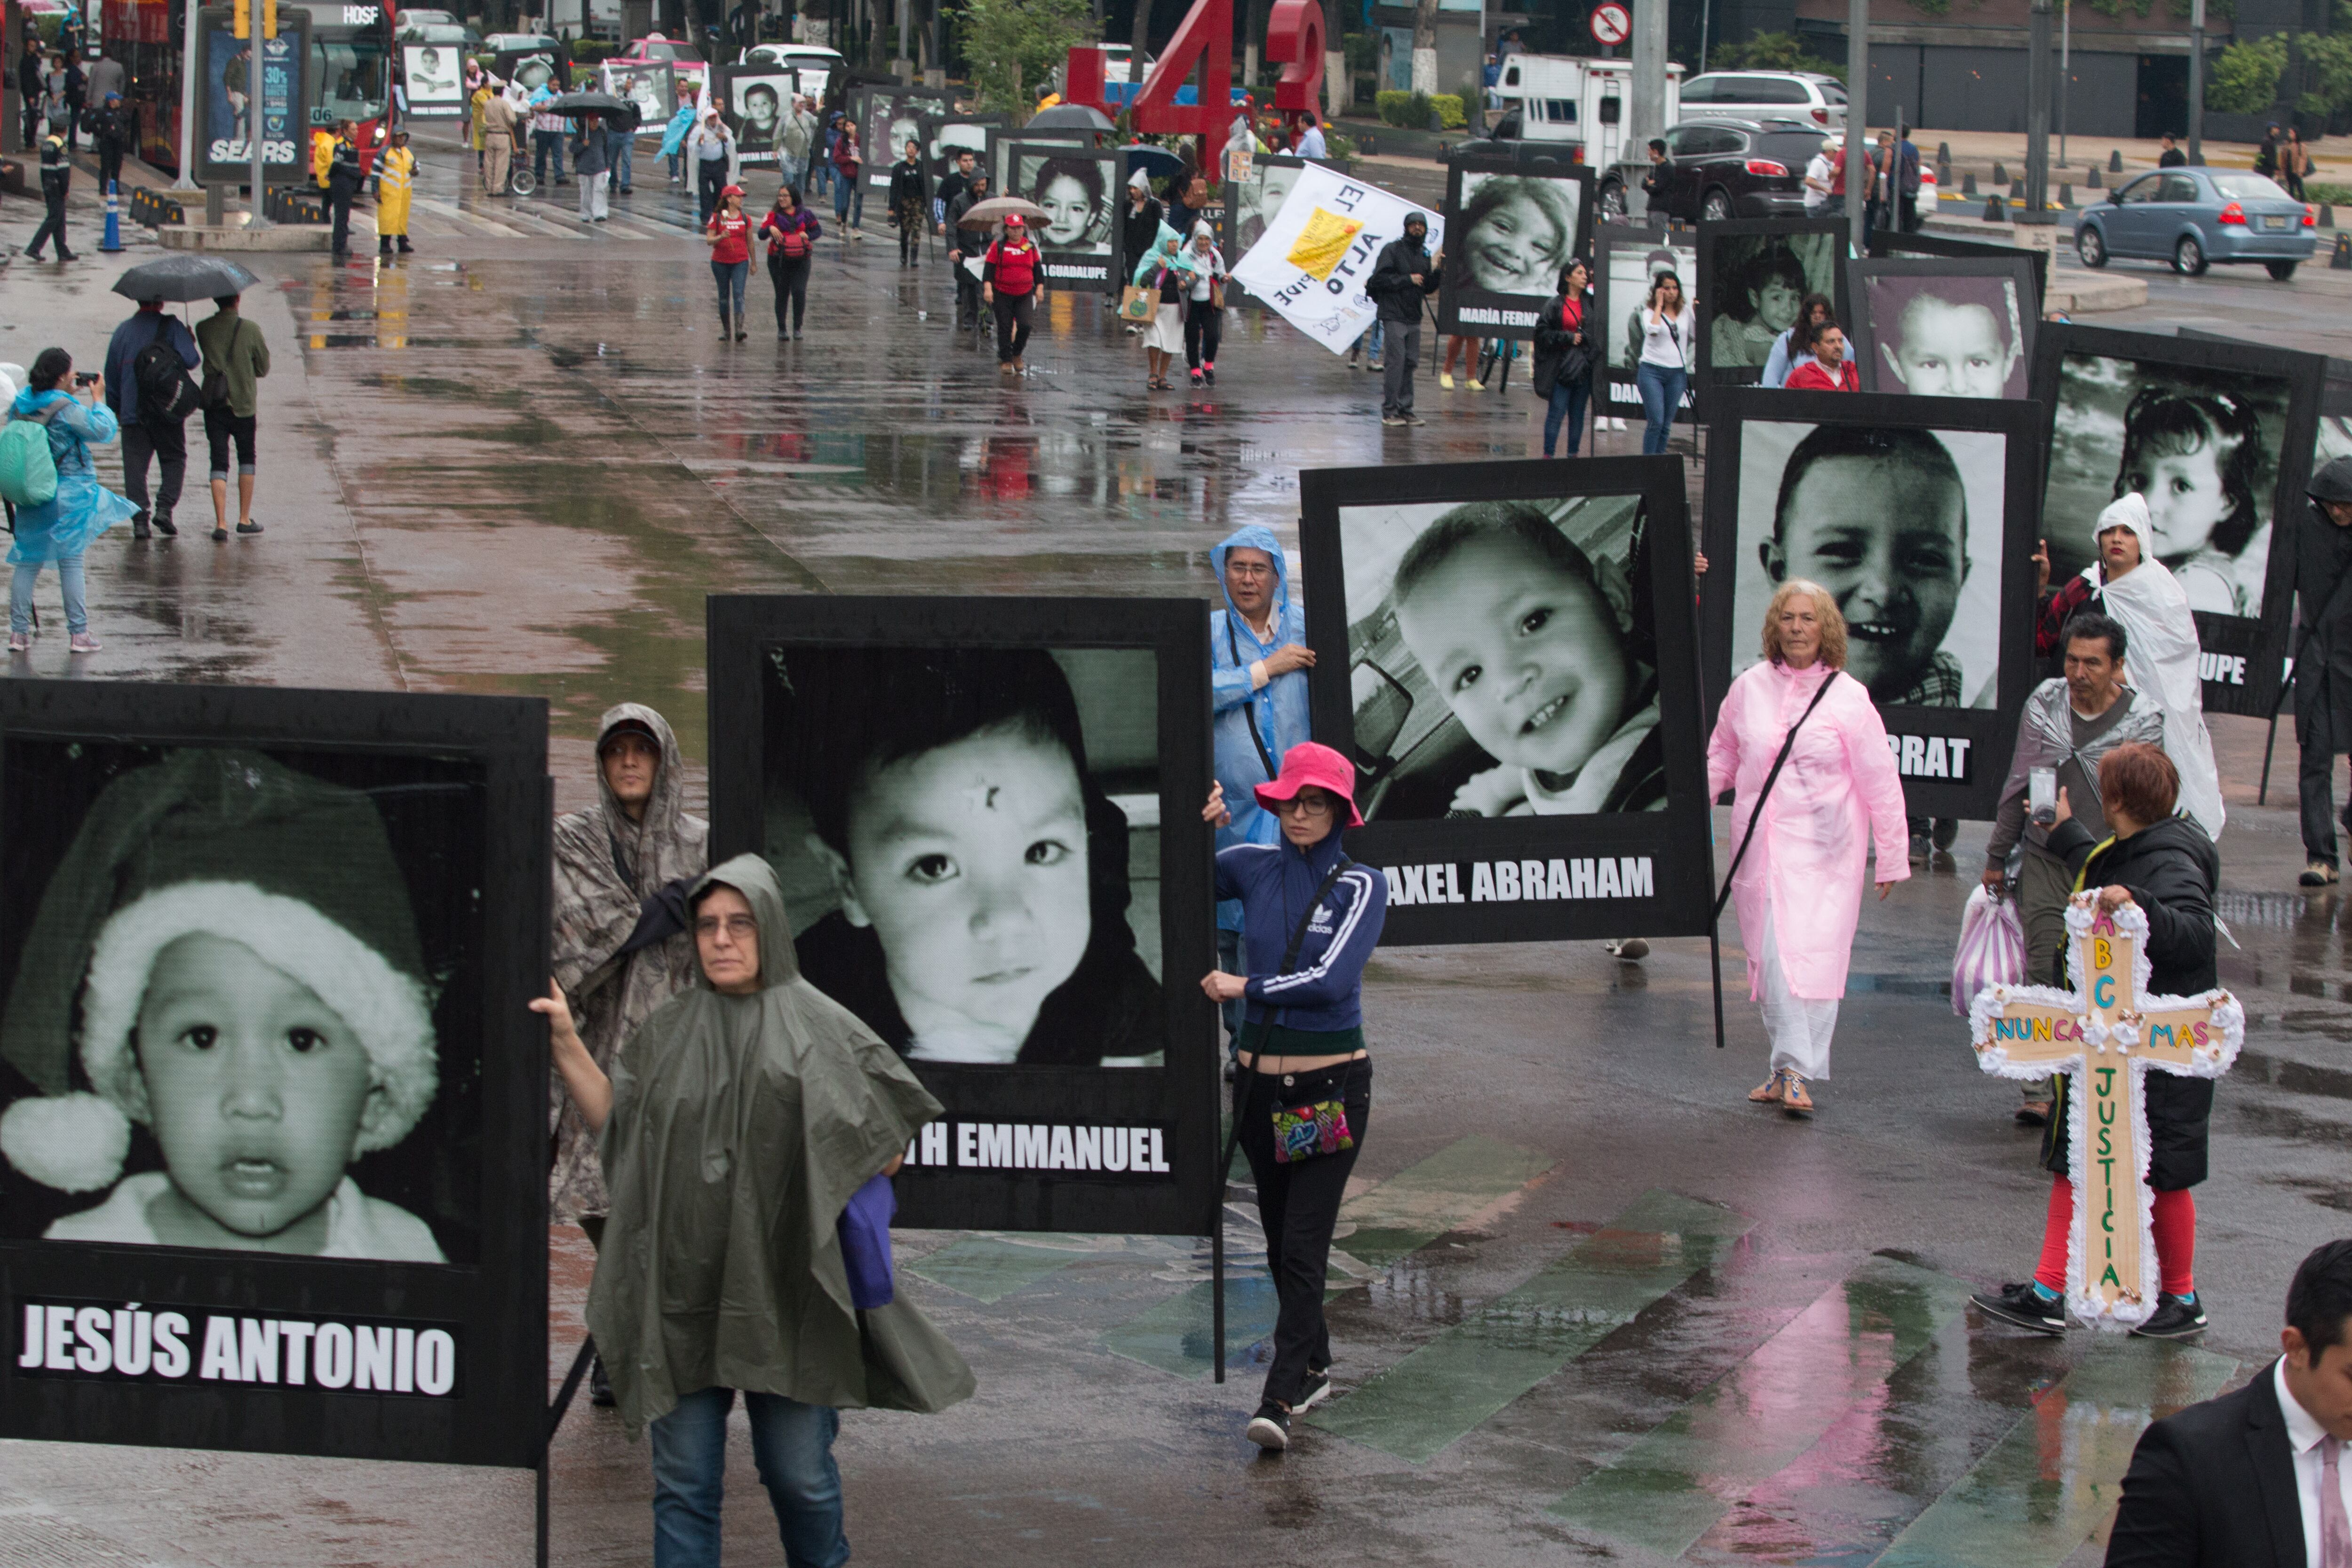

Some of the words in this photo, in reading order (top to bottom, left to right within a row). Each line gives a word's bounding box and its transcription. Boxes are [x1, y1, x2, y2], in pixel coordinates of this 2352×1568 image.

[1048, 264, 1107, 280] GUADALUPE
[1382, 863, 1465, 906] AXEL
[1471, 857, 1654, 902] ABRAHAM
[1996, 1017, 2085, 1043] NUNCA
[2150, 1021, 2209, 1049] MAS
[957, 1122, 1170, 1172] EMMANUEL
[2095, 1067, 2120, 1288] JUSTICIA
[18, 1302, 191, 1378] JESÚS
[199, 1315, 455, 1396] ANTONIO
